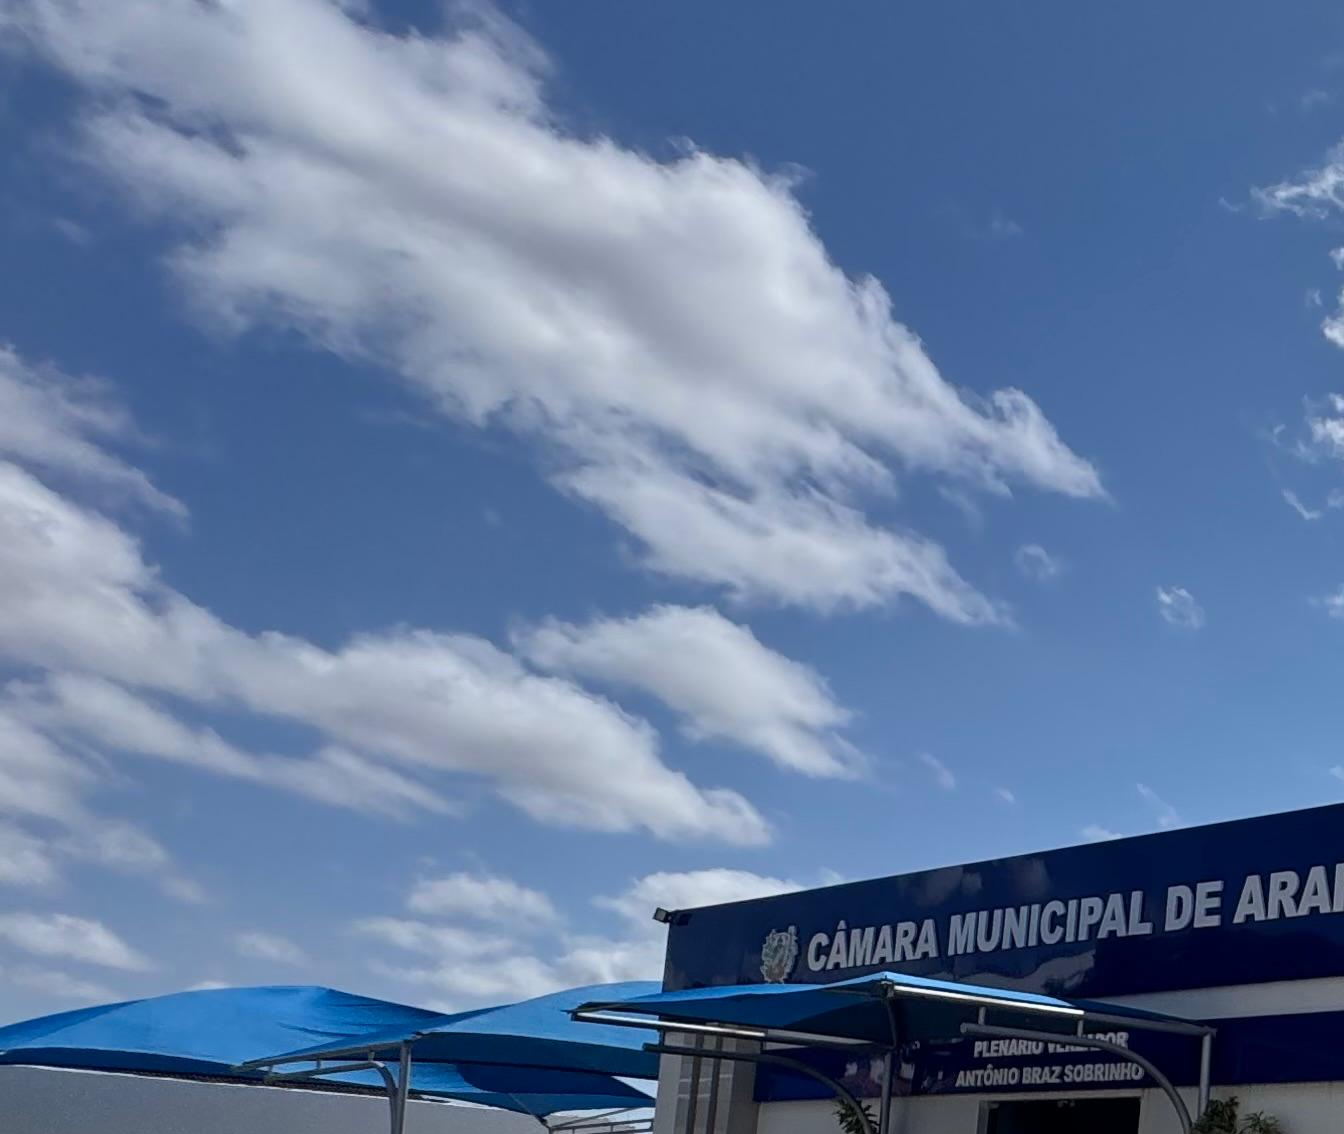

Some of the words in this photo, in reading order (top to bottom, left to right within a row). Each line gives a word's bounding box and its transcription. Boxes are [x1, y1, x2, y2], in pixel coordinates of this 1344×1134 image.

[807, 920, 938, 971] CÂMARA
[947, 890, 1153, 956] MUNICIPAL
[1164, 880, 1224, 931] DE
[955, 1064, 1019, 1087] ANTÔNIO
[1022, 1065, 1063, 1084] BRAZ
[1063, 1062, 1145, 1082] SOBRINHO
